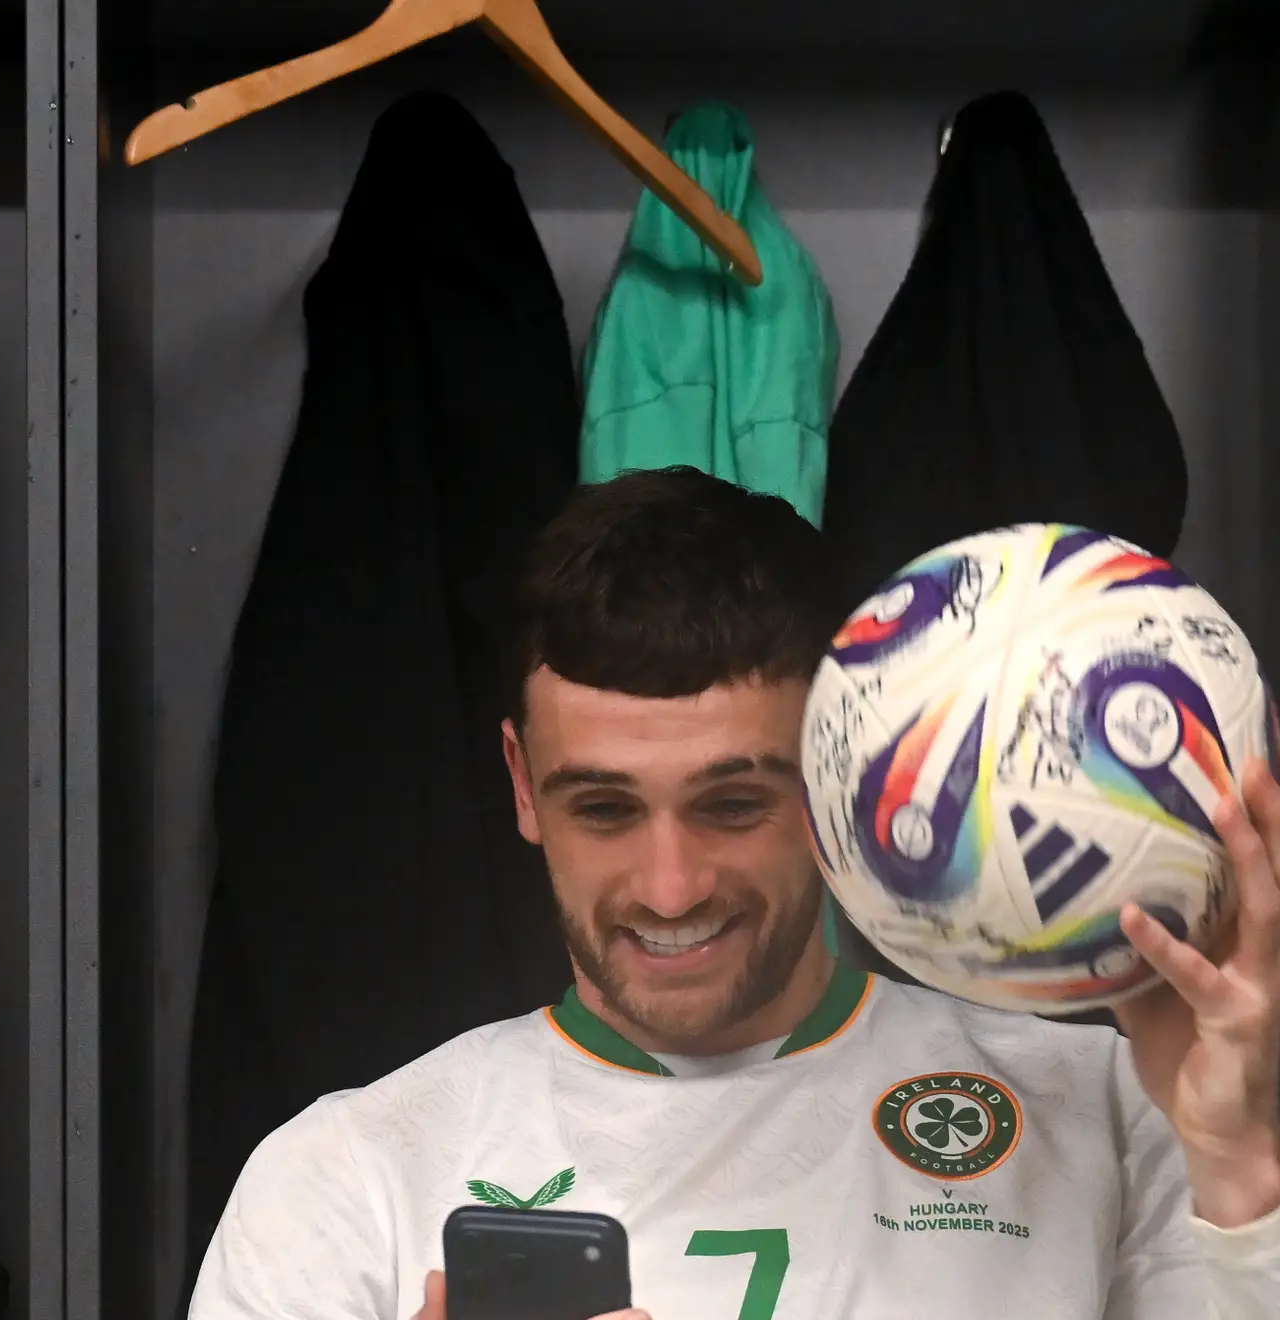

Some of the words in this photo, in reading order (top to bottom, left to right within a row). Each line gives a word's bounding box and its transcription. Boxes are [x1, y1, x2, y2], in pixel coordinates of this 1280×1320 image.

[886, 1078, 1001, 1109] IRELAND
[908, 1151, 996, 1173] FOOTBALL
[909, 1202, 988, 1217] HUNGARY
[873, 1213, 900, 1232] 16th
[903, 1217, 995, 1232] NOVEMBER
[998, 1221, 1030, 1239] 2025
